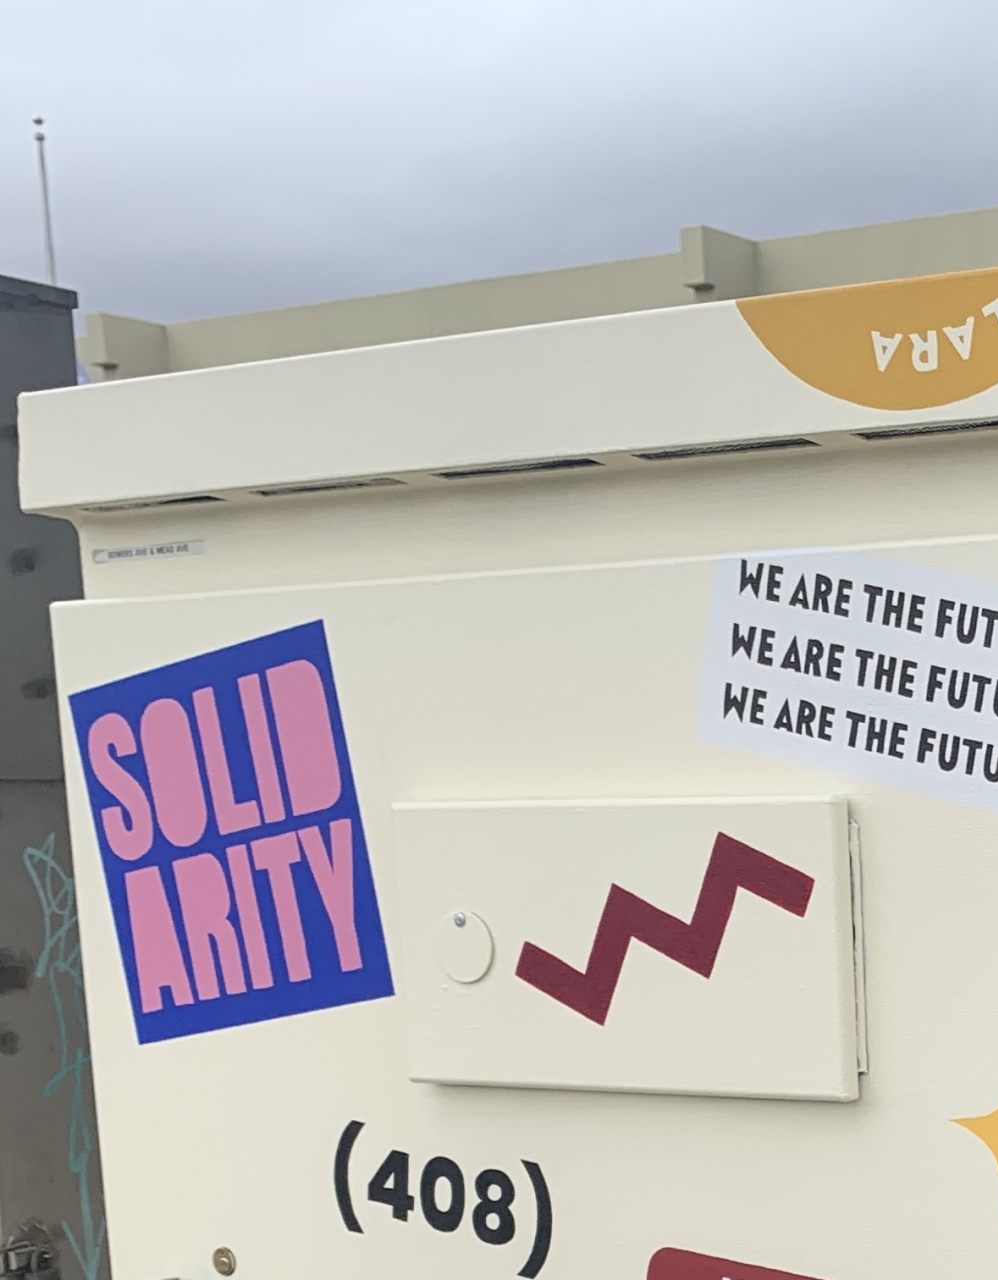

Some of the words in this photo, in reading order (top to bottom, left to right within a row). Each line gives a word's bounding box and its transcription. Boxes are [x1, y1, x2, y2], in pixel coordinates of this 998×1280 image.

[136, 548, 147, 556] AVE
[150, 547, 154, 555] &
[177, 544, 188, 552] AVE
[739, 558, 784, 602] WE
[788, 573, 853, 618] ARE
[863, 583, 927, 634] THE
[731, 622, 776, 666] WE
[780, 636, 845, 681] ARE
[854, 649, 918, 699] THE
[723, 682, 767, 725] WE
[772, 697, 836, 742] ARE
[845, 711, 908, 759] THE
[87, 659, 342, 861] SOLID
[124, 818, 363, 1014] ARITY
[334, 1119, 553, 1280] (408)
